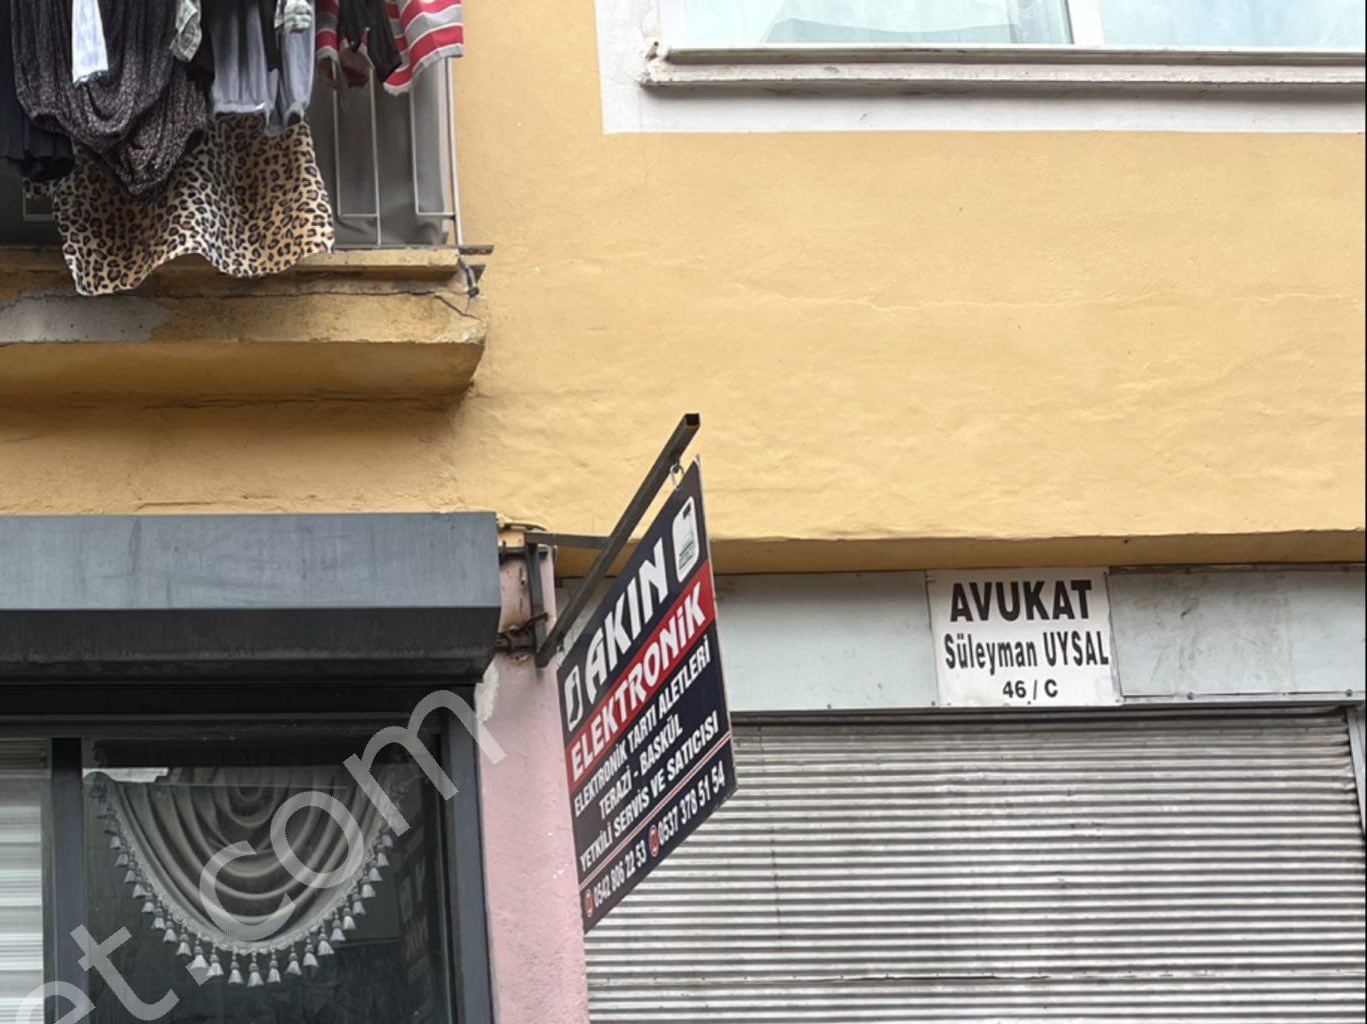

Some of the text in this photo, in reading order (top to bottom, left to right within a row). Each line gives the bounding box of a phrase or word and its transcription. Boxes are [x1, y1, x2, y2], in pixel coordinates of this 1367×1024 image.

[585, 537, 668, 705] AKIN
[944, 631, 1109, 675] Süleyman UYSAL
[950, 580, 1092, 622] AVUKAT
[573, 636, 710, 818] ELEKTRONİK TARTI ALETLERİ
[1003, 679, 1058, 700] 46 / C
[580, 709, 718, 874] YETKİLİ SERVİS VE SATICISI
[599, 766, 631, 822] TERAZİ
[639, 707, 683, 777] BASKÜL
[624, 849, 635, 878] 22
[635, 838, 646, 868] 53
[657, 804, 679, 847] 0537
[679, 786, 697, 826] 378
[698, 773, 710, 808] 51
[711, 758, 725, 796] 54
